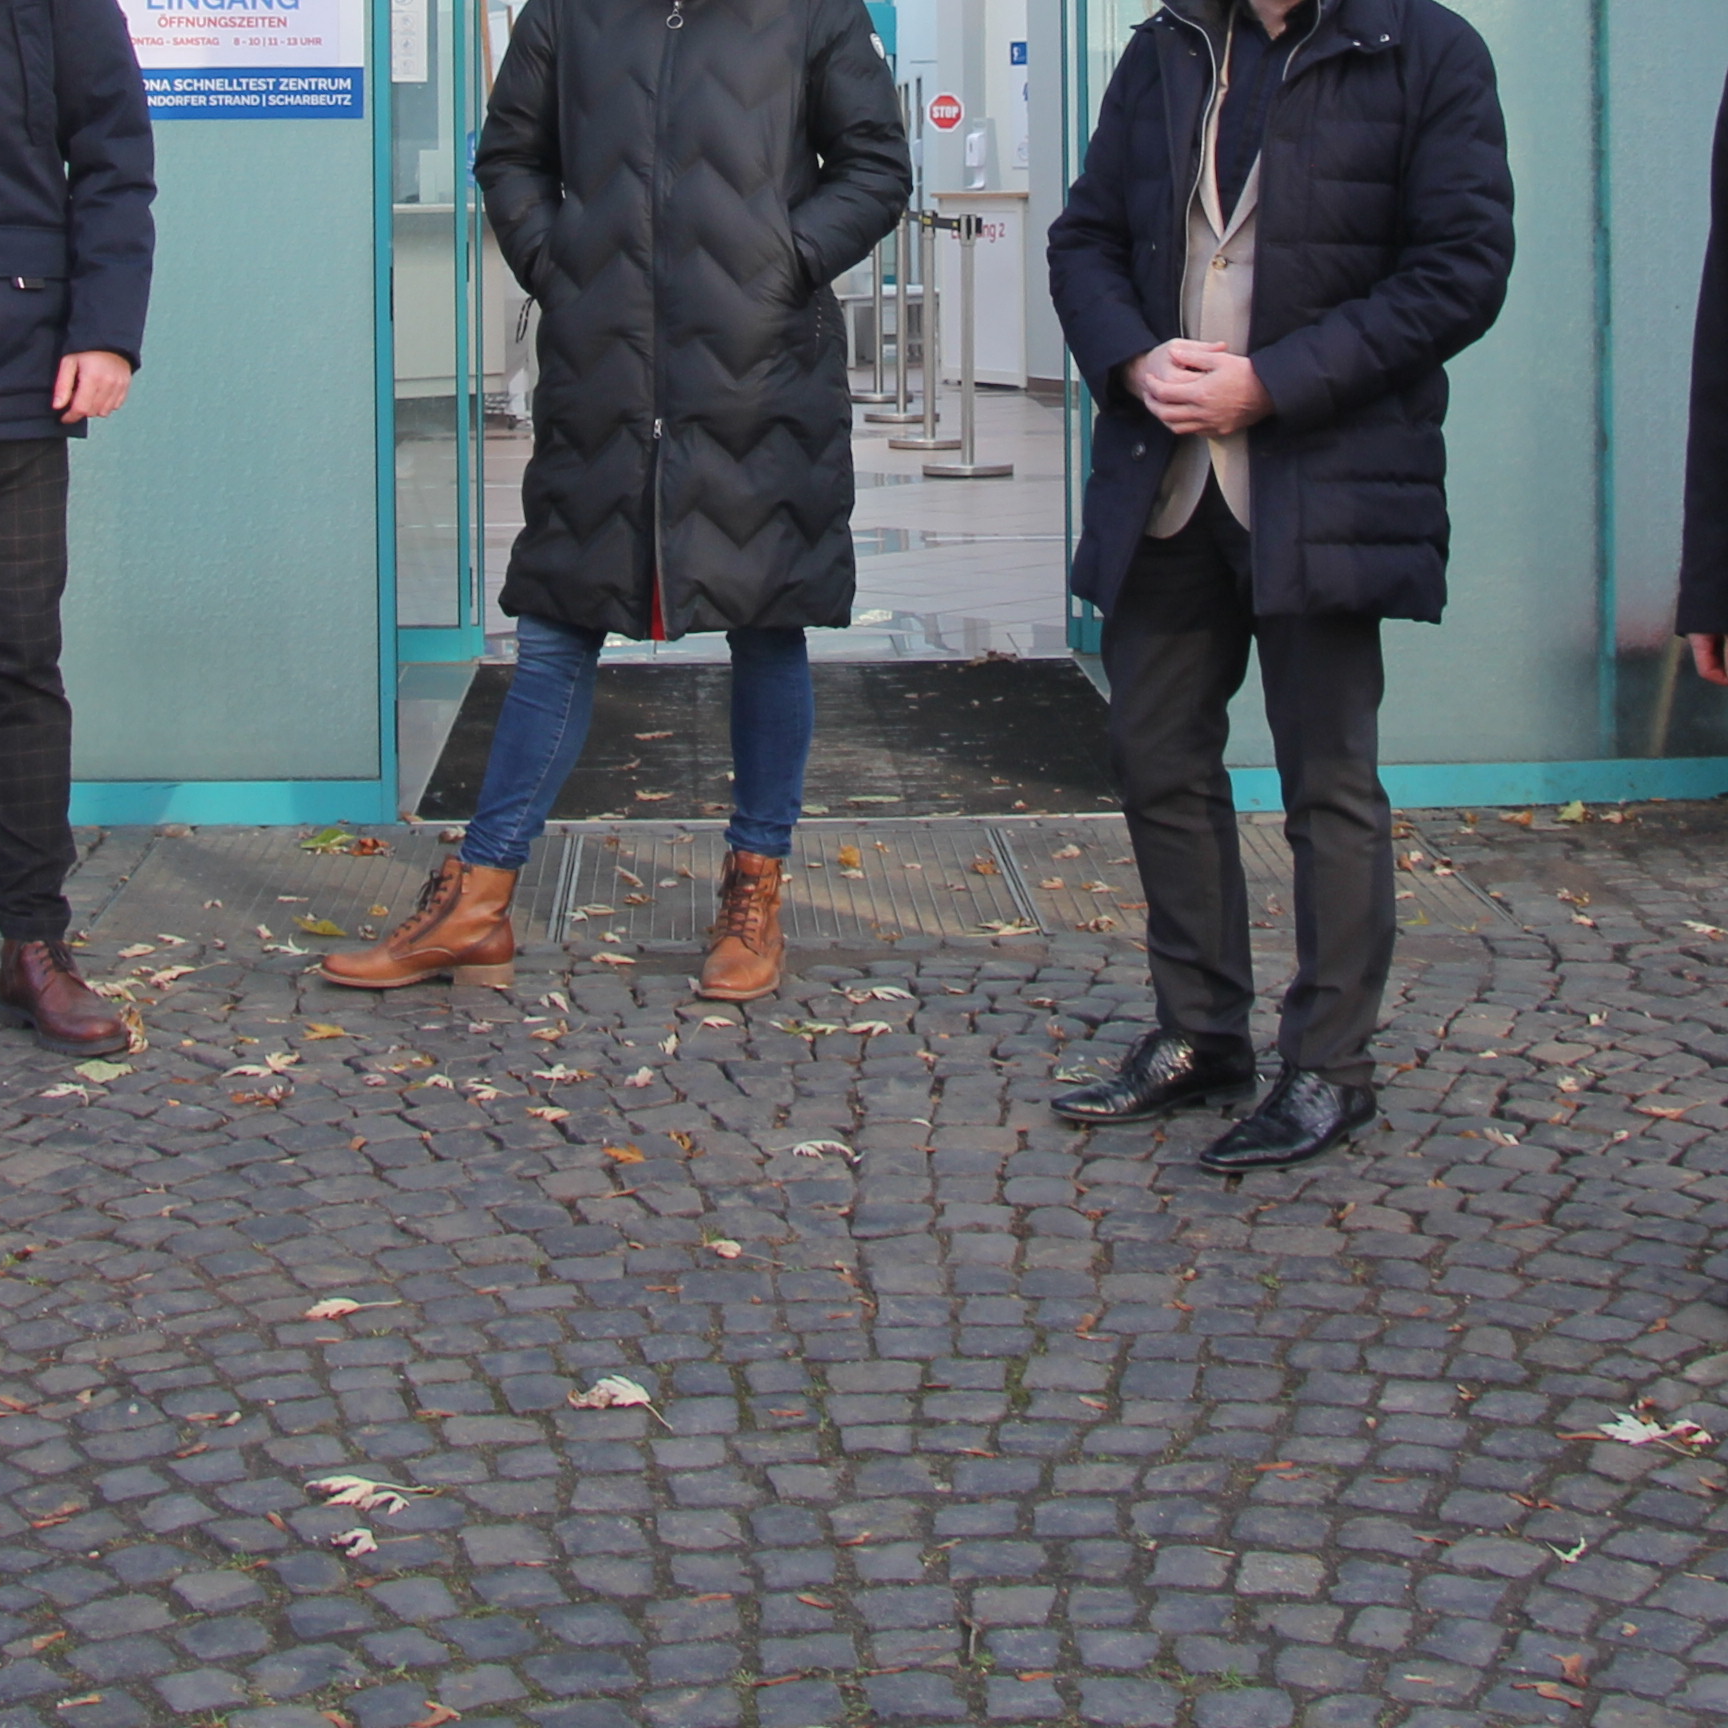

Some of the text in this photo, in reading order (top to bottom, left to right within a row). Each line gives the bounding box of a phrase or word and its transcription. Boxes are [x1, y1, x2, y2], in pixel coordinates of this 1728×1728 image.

[157, 13, 288, 28] ÖFFNUNGSZEITEN
[131, 37, 164, 46] ONTAG
[172, 36, 220, 46] SAMSTAG
[233, 37, 240, 46] 8
[249, 36, 261, 46] 10
[268, 36, 279, 46] 11
[286, 36, 298, 46] 13
[300, 36, 323, 46] UHR
[173, 78, 274, 91] SCHNELLTEST
[279, 78, 352, 91] ZENTRUM
[147, 95, 207, 107] NDORFER
[209, 94, 261, 107] STRAND
[268, 94, 352, 106] SCHARBEUTZ
[932, 106, 960, 119] STOP
[998, 222, 1006, 237] 2
